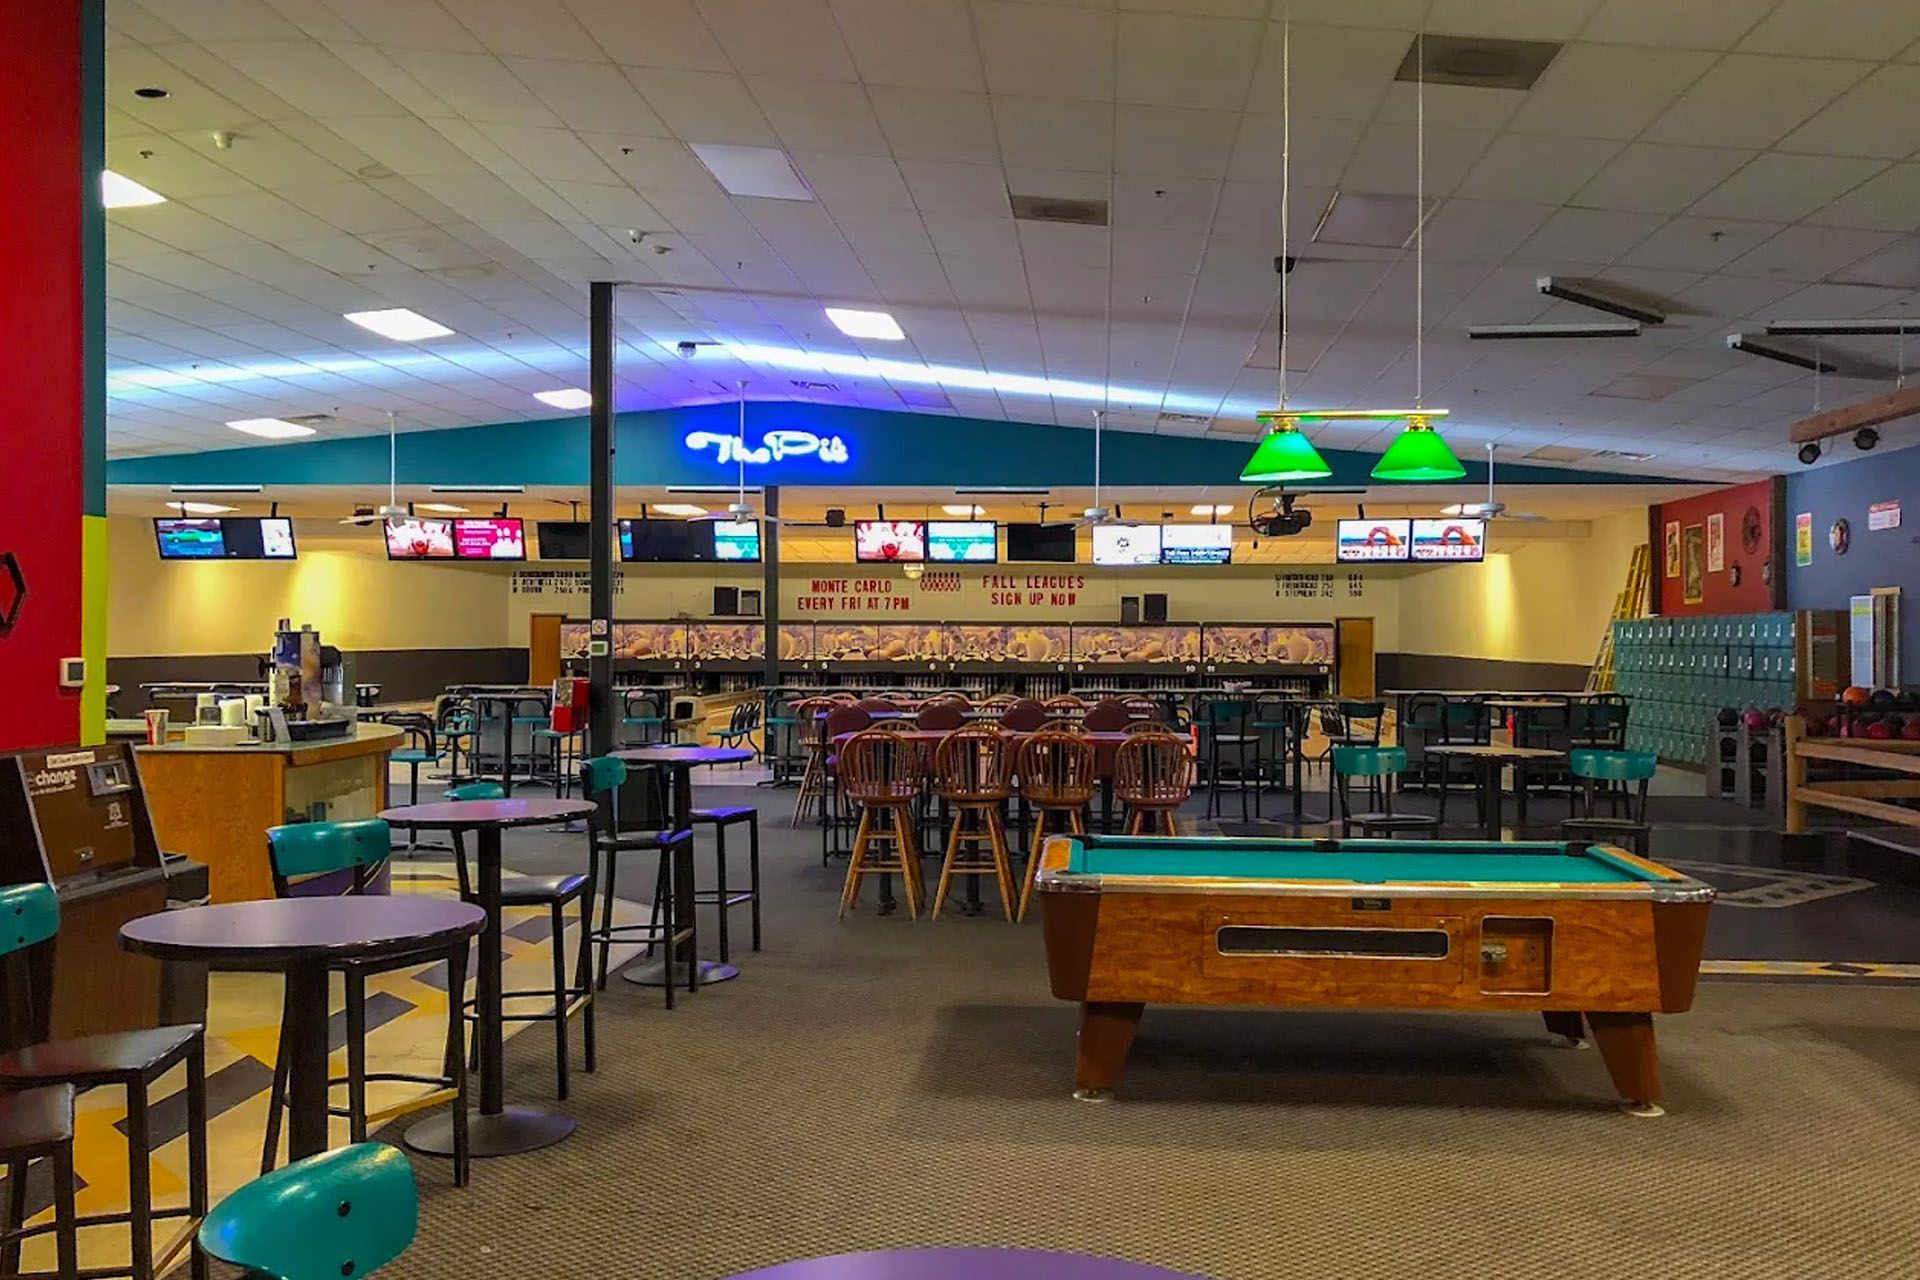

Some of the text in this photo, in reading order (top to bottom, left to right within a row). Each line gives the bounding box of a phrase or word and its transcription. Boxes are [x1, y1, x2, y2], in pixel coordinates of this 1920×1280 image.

[685, 430, 849, 464] The Pit
[811, 580, 892, 593] MONTE CARLO
[982, 575, 1085, 589] FALL LEAGUES
[797, 597, 834, 610] EVERY
[841, 597, 861, 610] FRI
[867, 597, 880, 610] AT
[991, 592, 1076, 606] SIGN UP NOW
[36, 769, 77, 786] change
